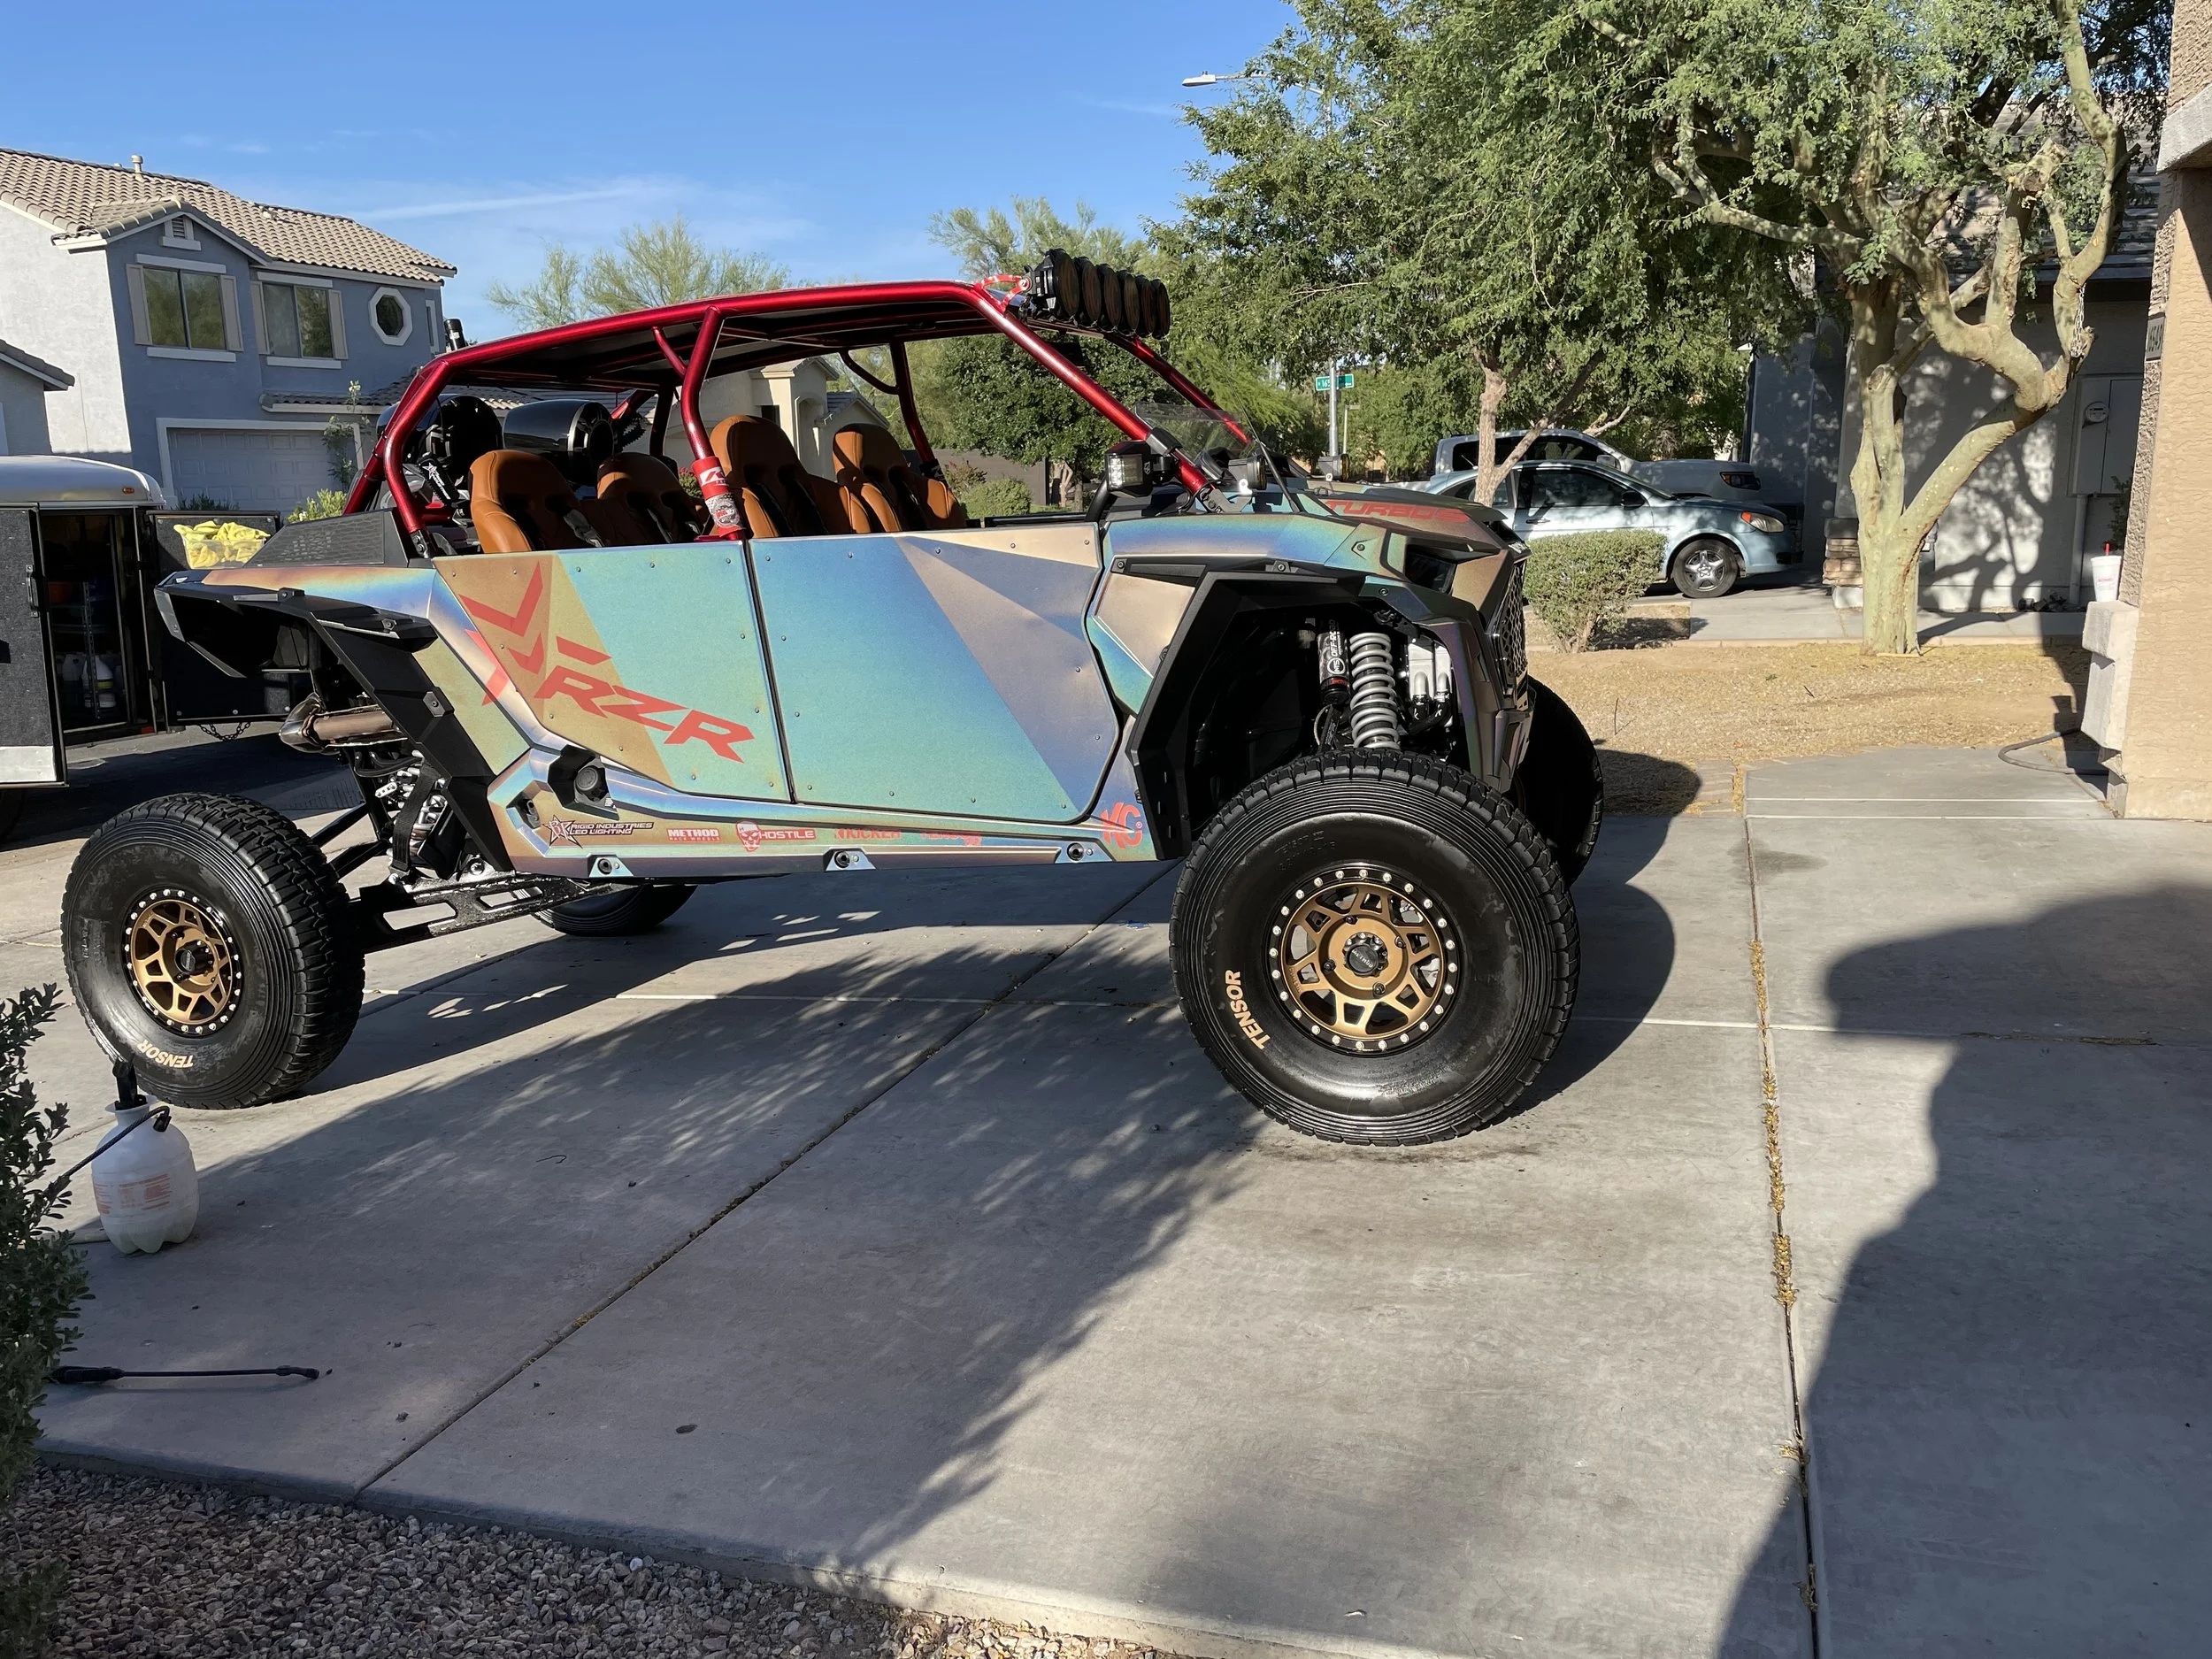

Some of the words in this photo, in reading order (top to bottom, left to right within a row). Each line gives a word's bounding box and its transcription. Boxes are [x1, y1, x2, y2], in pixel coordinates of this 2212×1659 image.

[534, 665, 755, 764] RZR
[759, 830, 815, 839] HOSTILE
[1100, 802, 1142, 849] KC
[1225, 970, 1271, 1050] TENSOR
[136, 1039, 194, 1068] TENSOR
